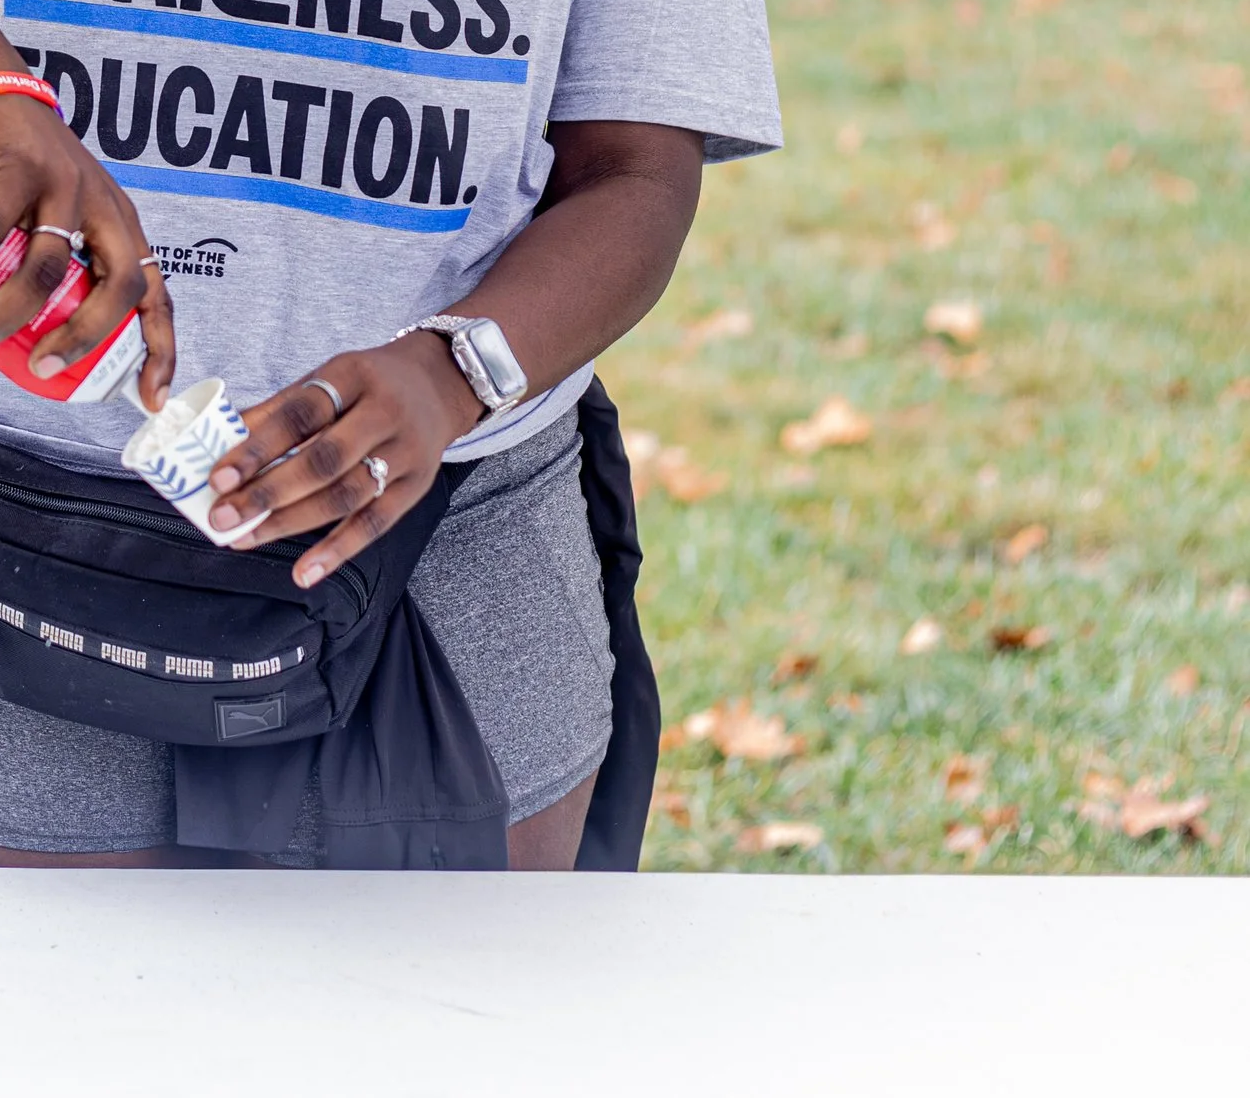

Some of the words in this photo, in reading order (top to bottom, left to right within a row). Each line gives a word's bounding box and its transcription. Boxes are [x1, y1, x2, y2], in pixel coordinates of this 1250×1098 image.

[12, 45, 478, 206] DUCATION.
[150, 245, 170, 258] UT
[173, 247, 193, 260] OF
[196, 250, 226, 264] THE
[160, 260, 224, 278] RKNESS
[39, 621, 84, 653] PUMA
[101, 642, 147, 670] PUMA
[165, 655, 214, 679] PUMA
[232, 656, 282, 679] PUMA
